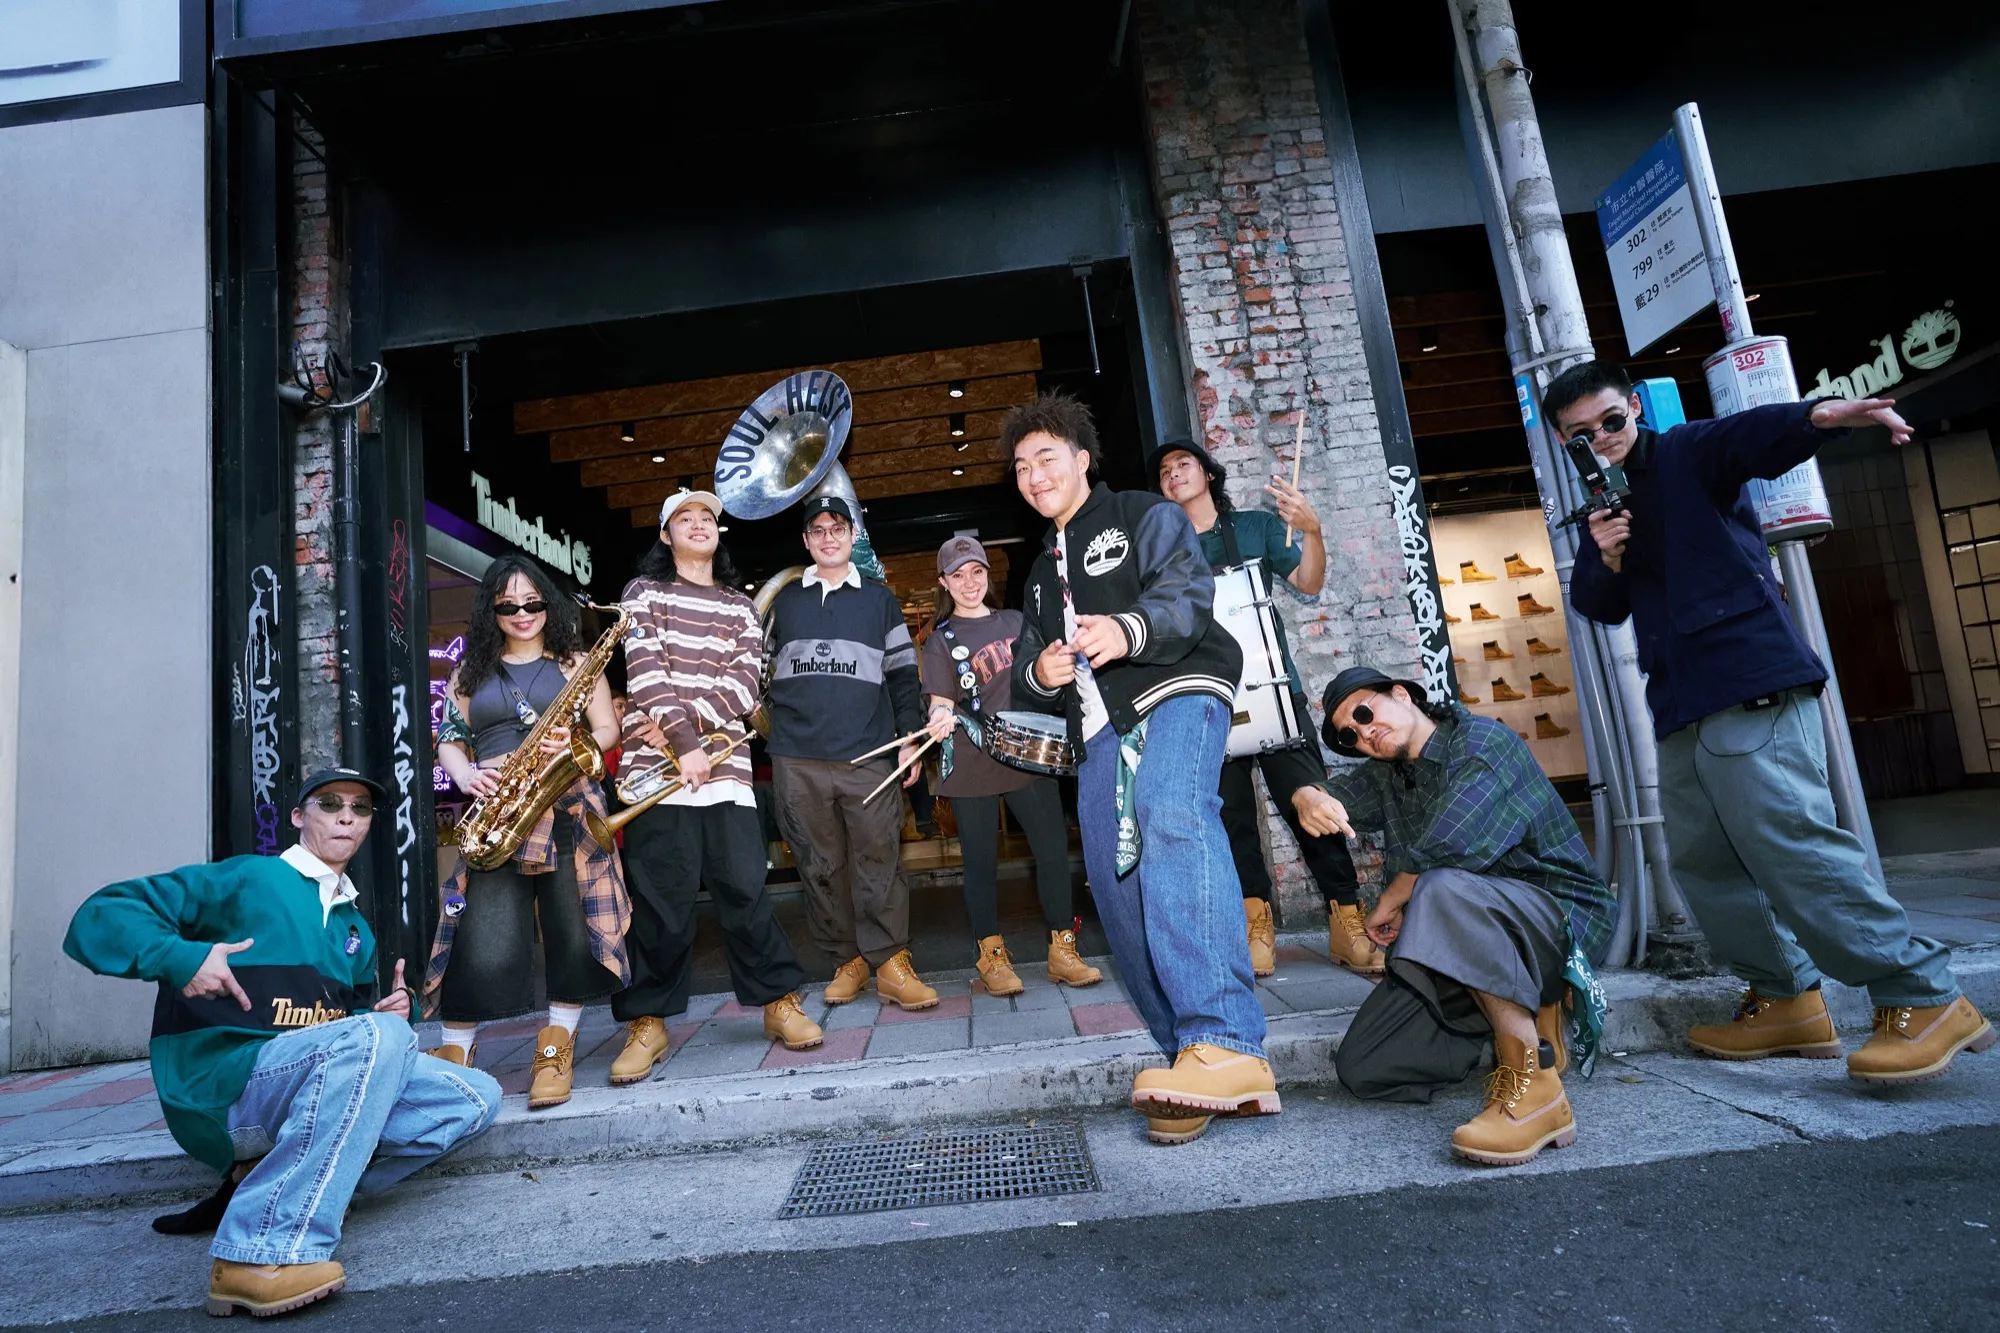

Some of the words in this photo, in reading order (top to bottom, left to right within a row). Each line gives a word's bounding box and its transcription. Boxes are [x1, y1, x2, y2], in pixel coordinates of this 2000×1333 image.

[1608, 216, 1623, 229] Taipei
[1622, 194, 1646, 215] Municipal
[1646, 177, 1667, 198] Hospital
[1668, 166, 1675, 177] of
[1634, 197, 1655, 215] Chinese
[1655, 174, 1680, 197] Medicine
[1627, 228, 1647, 253] 302
[1632, 256, 1653, 280] 799
[1734, 350, 1766, 368] 302
[715, 405, 779, 484] SOUL
[786, 371, 852, 428] HEIST
[471, 470, 573, 575] Timberland
[790, 657, 857, 675] Timberland
